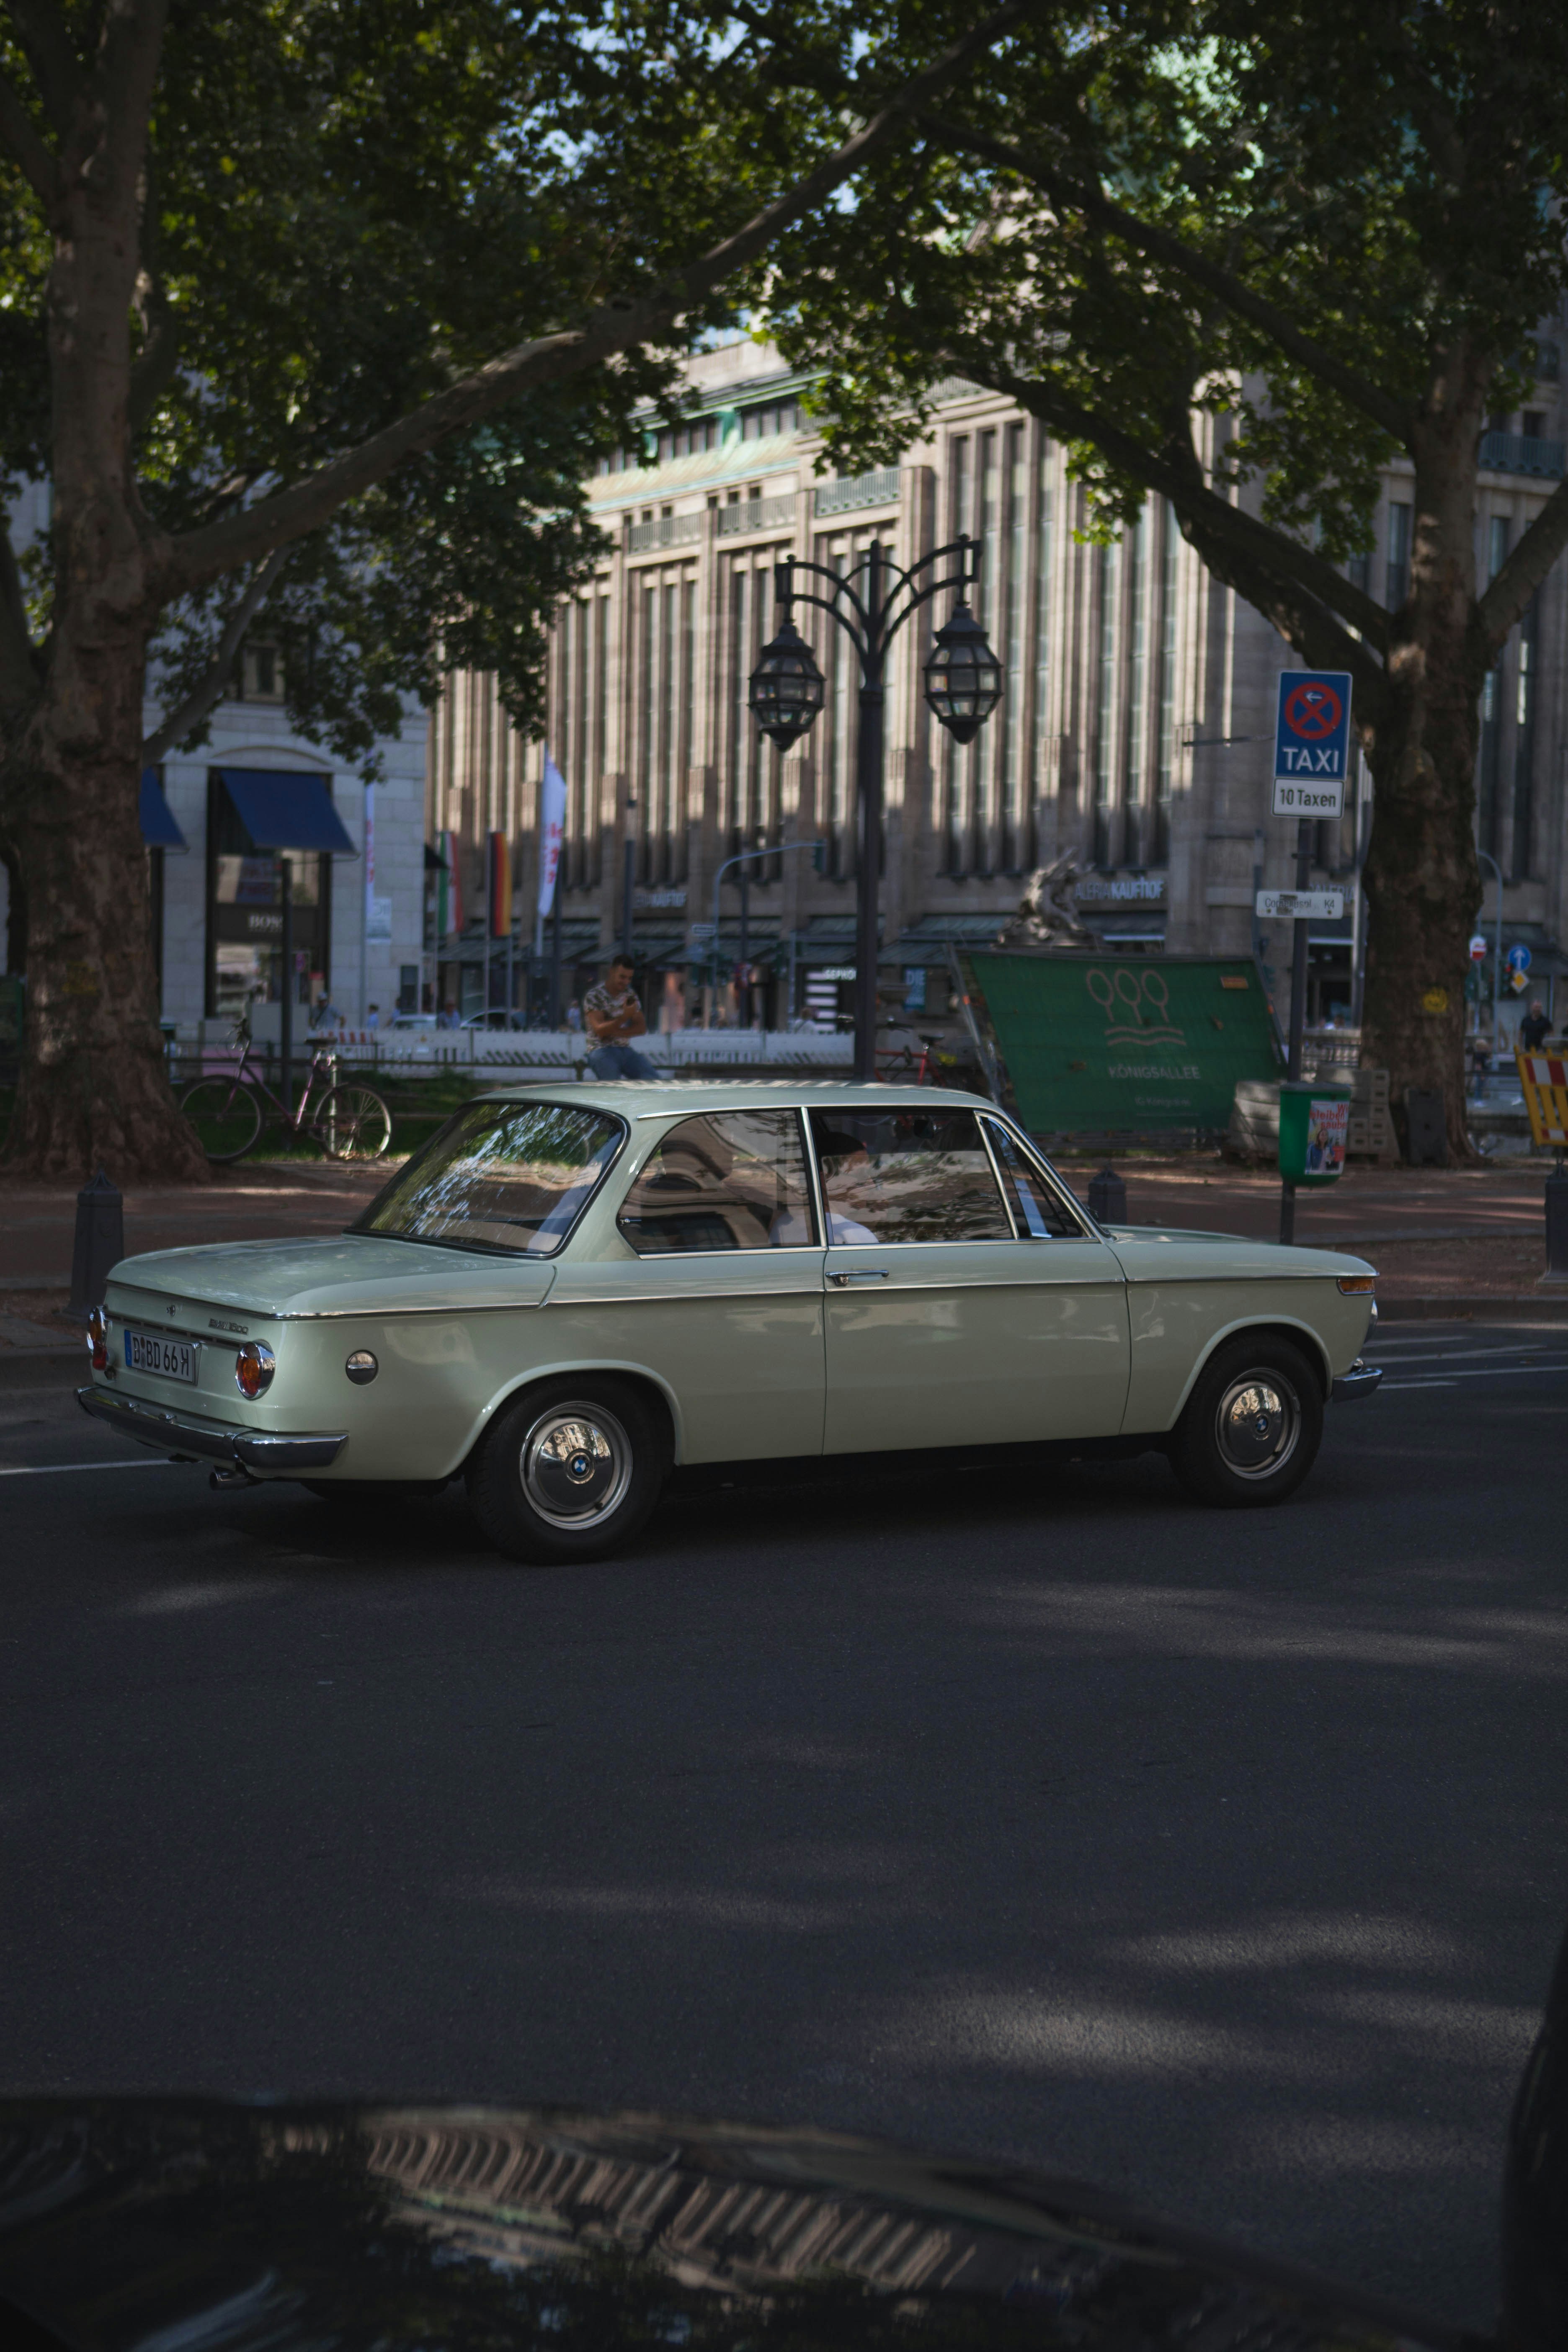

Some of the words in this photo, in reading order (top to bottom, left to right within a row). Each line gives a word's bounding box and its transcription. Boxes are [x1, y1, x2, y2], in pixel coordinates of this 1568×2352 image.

[1282, 748, 1339, 773] TAXI
[1280, 788, 1294, 805] 10
[1297, 789, 1337, 807] Taxen
[1325, 899, 1335, 909] K4
[1108, 1064, 1201, 1079] KÖNIGSALLEE
[133, 1337, 141, 1364] D
[147, 1340, 161, 1369] BD
